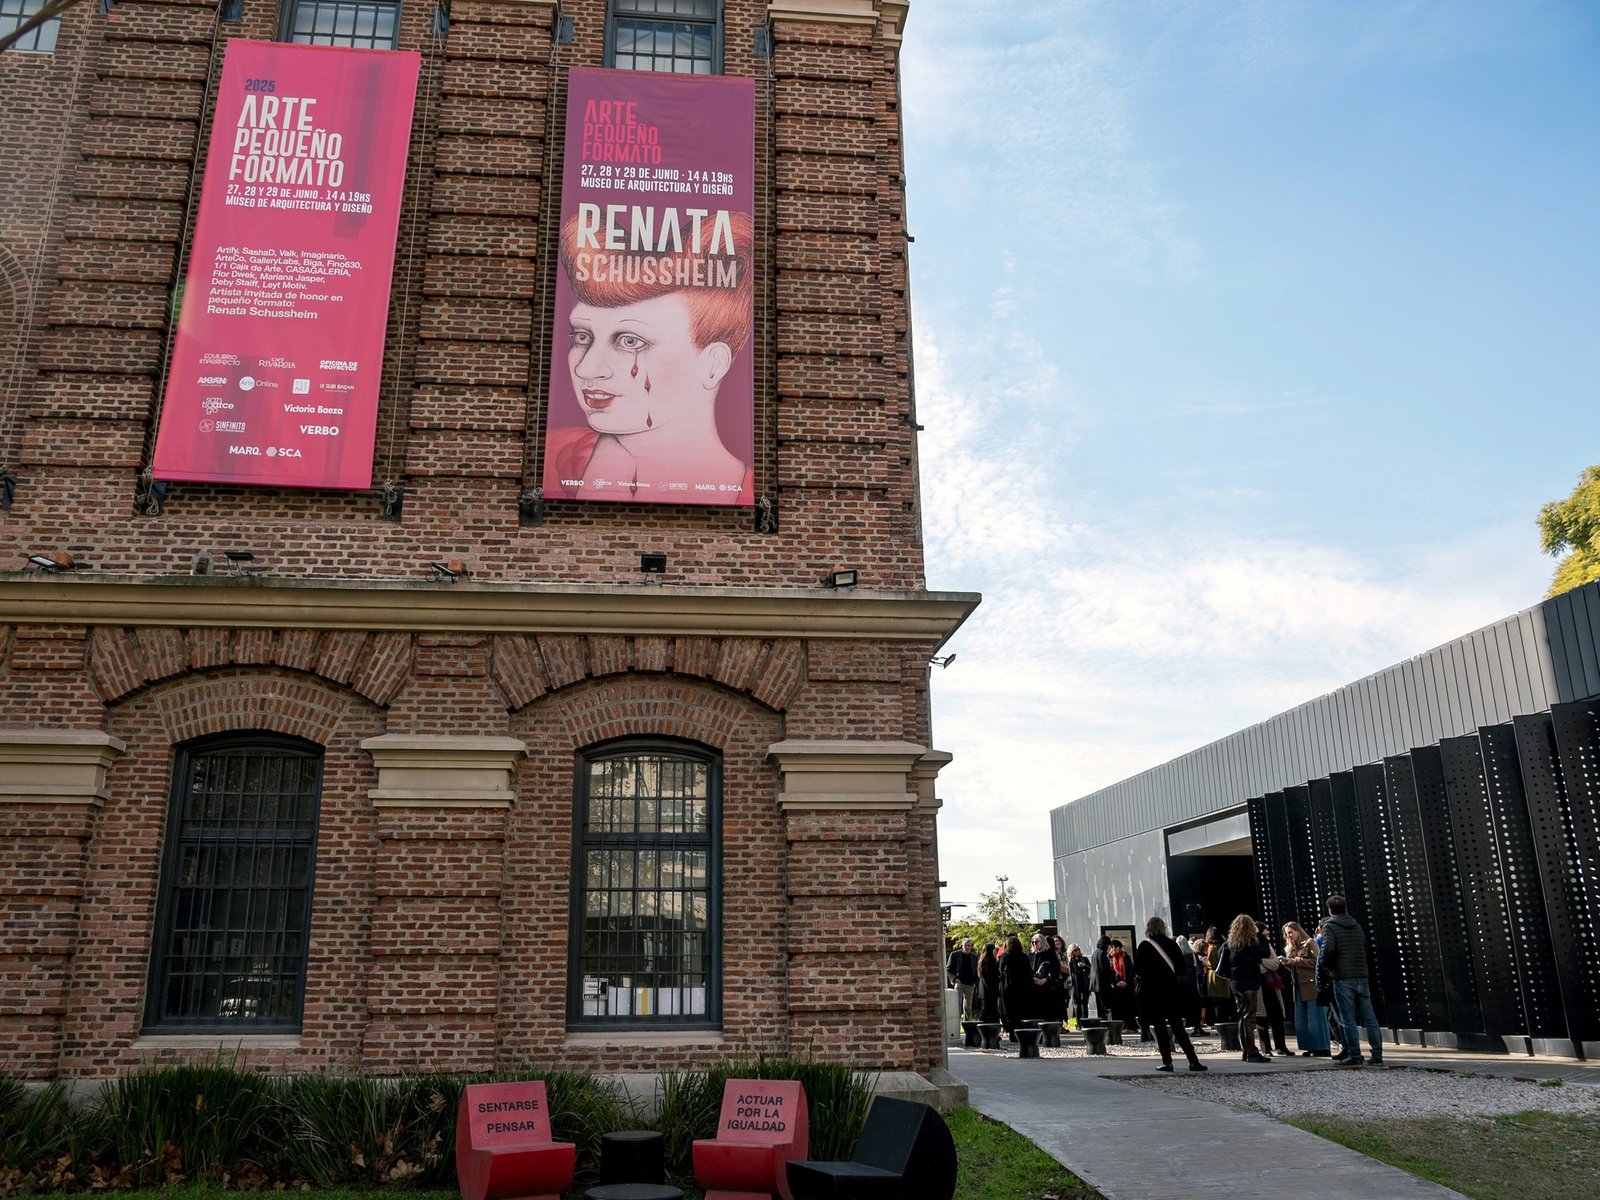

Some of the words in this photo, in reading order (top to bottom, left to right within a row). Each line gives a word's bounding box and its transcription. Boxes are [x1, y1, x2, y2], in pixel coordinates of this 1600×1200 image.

[245, 78, 276, 93] 2025
[237, 94, 316, 131] ARTE
[584, 100, 638, 125] ARTE
[583, 123, 658, 145] PEQUEÑO
[233, 127, 342, 159] PEQUEÑO
[582, 142, 662, 164] FORMATO
[228, 154, 344, 187] FORMATO
[581, 165, 597, 177] 27,
[600, 165, 612, 176] 28
[615, 167, 620, 176] Y
[624, 167, 636, 178] 29
[639, 168, 650, 179] DE
[652, 168, 679, 180] JUNIO
[688, 170, 700, 181] 14
[702, 172, 708, 182] A
[711, 171, 733, 184] 19HS
[581, 177, 611, 189] MUSEO
[614, 179, 625, 190] DE
[627, 179, 691, 193] ARQUITECTURA
[694, 183, 699, 193] Y
[703, 183, 733, 195] DISEÑO
[227, 184, 241, 195] 27,
[244, 186, 256, 196] 28
[259, 187, 264, 196] Y
[266, 187, 278, 197] 29
[280, 189, 291, 198] DE
[293, 189, 318, 199] JUNIO
[326, 190, 337, 200] 14
[339, 192, 345, 201] A
[348, 192, 371, 202] 19HS
[225, 196, 255, 208] MUSEO
[257, 198, 268, 208] DE
[270, 199, 332, 211] ARQUITECTURA
[334, 203, 339, 211] Y
[342, 203, 373, 214] DISEÑO
[576, 203, 735, 255] RENATA
[242, 247, 277, 257] SashaD,
[279, 249, 298, 257] Valk,
[301, 251, 347, 260] Imaginario,
[230, 263, 248, 271] Caja
[251, 264, 262, 272] de
[250, 256, 301, 266] GalleryLabs,
[231, 271, 257, 280] Dwek,
[295, 275, 325, 283] Jasper,
[576, 253, 737, 288] SCHUSSHEIM
[211, 278, 233, 287] Deby
[262, 281, 280, 289] Leyt
[210, 287, 242, 296] Artista
[244, 289, 282, 298] invitada
[285, 291, 297, 299] de
[300, 291, 329, 301] honor
[208, 297, 251, 306] pequeño
[254, 298, 295, 307] formato:
[207, 305, 246, 315] Renata
[250, 306, 318, 319] Schussheim
[255, 380, 278, 388] Online
[284, 404, 315, 413] Victoria
[317, 405, 343, 415] Baeza
[215, 421, 246, 431] SINFINITO
[300, 425, 339, 436] VERBO
[229, 445, 262, 456] MARQ.
[278, 448, 301, 458] SCA
[561, 479, 584, 487] VERBO
[479, 1100, 539, 1113] SENTARSE
[737, 1095, 783, 1106] ACTUAR
[737, 1107, 761, 1118] POR
[764, 1109, 780, 1118] LA
[487, 1121, 535, 1133] PENSAR
[727, 1119, 786, 1132] IGUALDAD
